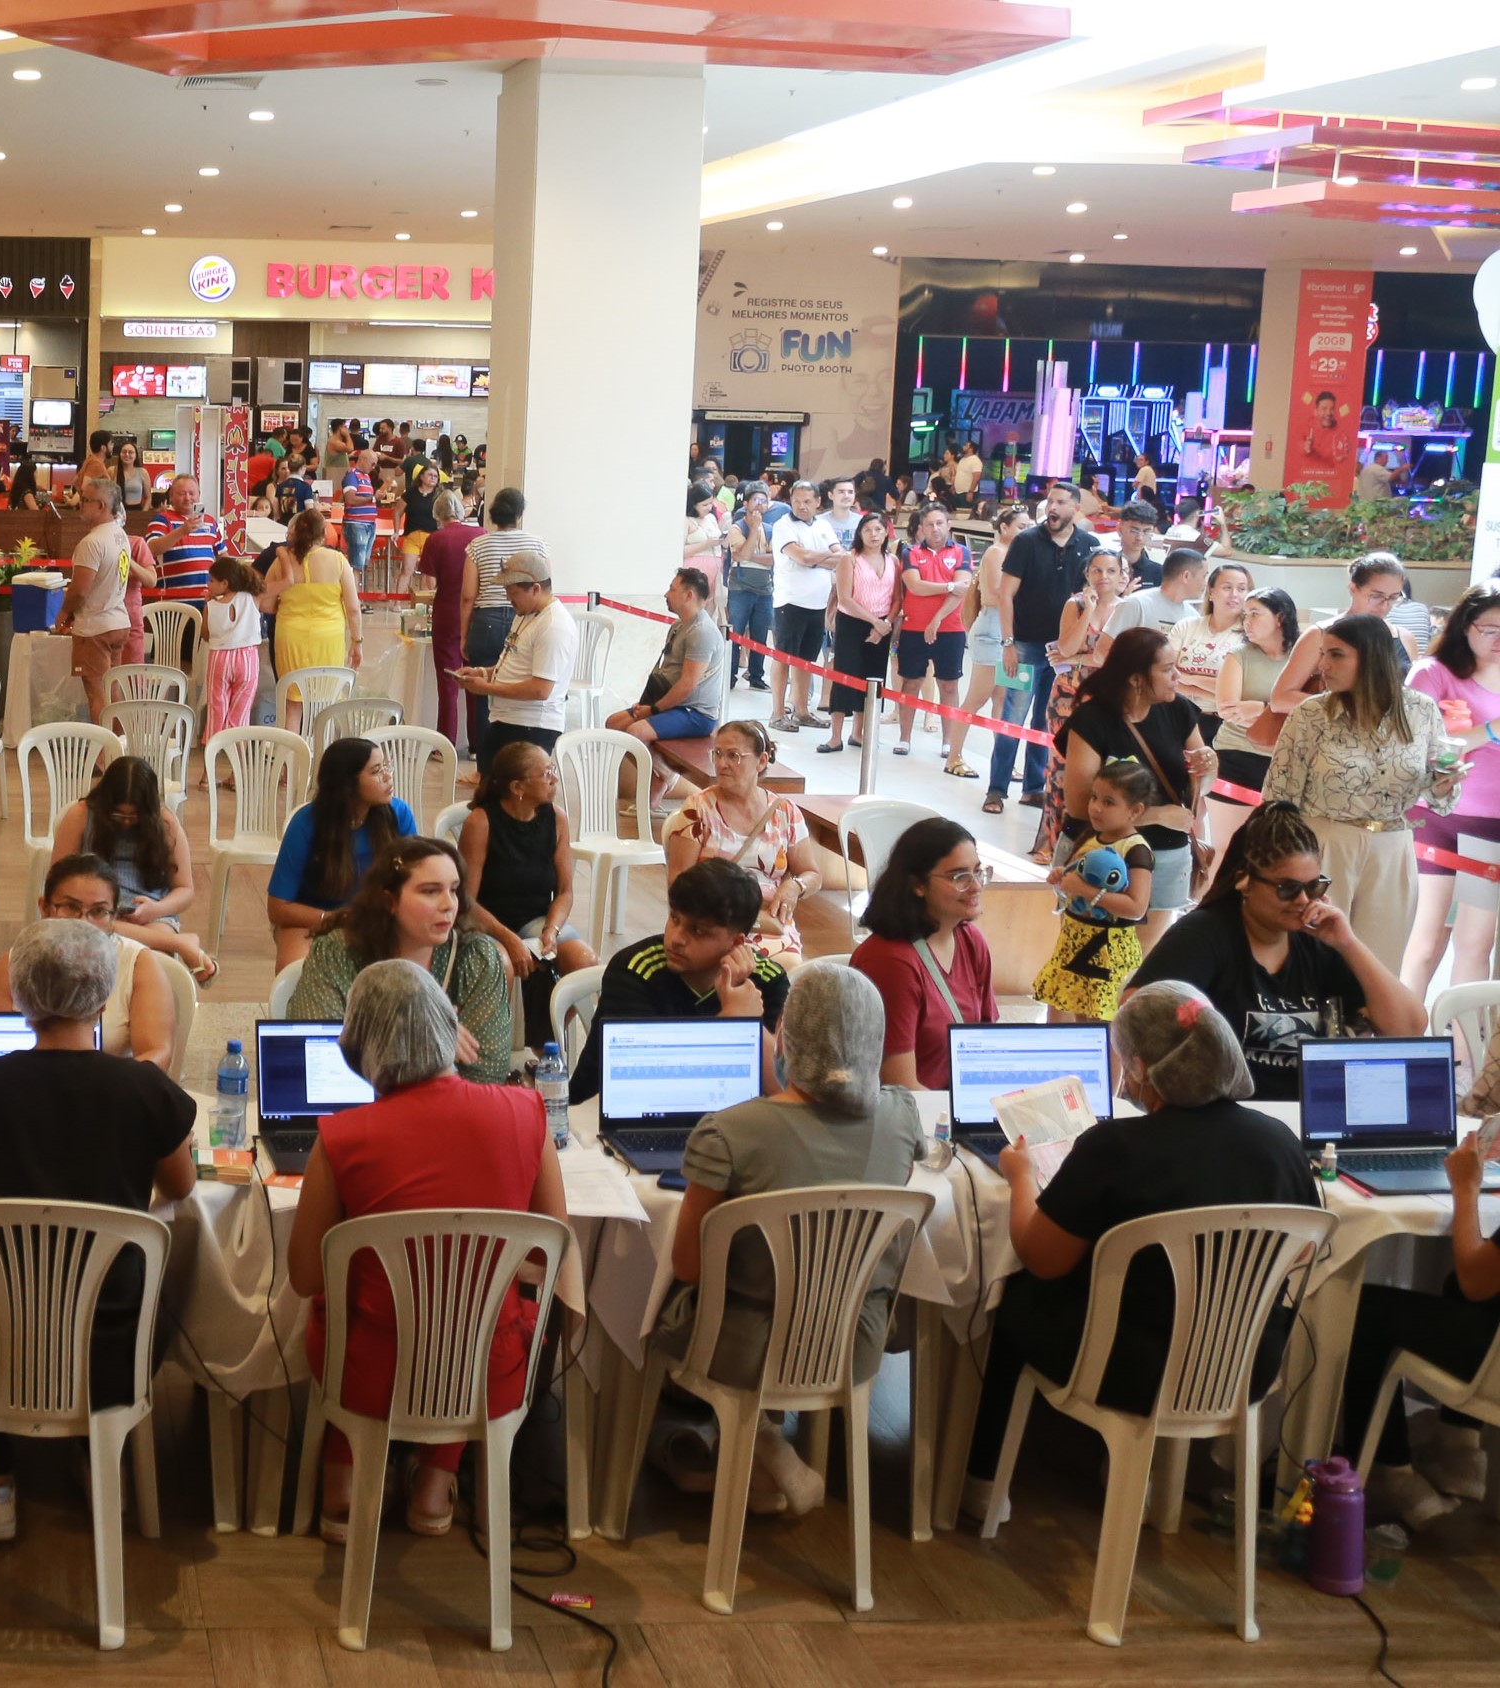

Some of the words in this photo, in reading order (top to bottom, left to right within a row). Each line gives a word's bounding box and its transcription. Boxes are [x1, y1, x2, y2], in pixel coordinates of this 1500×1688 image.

[197, 273, 229, 292] KING
[267, 262, 451, 301] BURGER
[747, 298, 797, 308] REGISTRE
[799, 300, 814, 309] OS
[816, 301, 843, 309] SEUS
[731, 310, 787, 319] MELHORES
[790, 311, 849, 322] MOMENTOS
[127, 323, 215, 337] SOBREMESAS
[780, 329, 852, 363] FUN
[1317, 336, 1347, 347] 20GB
[781, 363, 815, 373] PHOTO
[819, 365, 853, 374] BOOTH
[1318, 358, 1339, 373] 29
